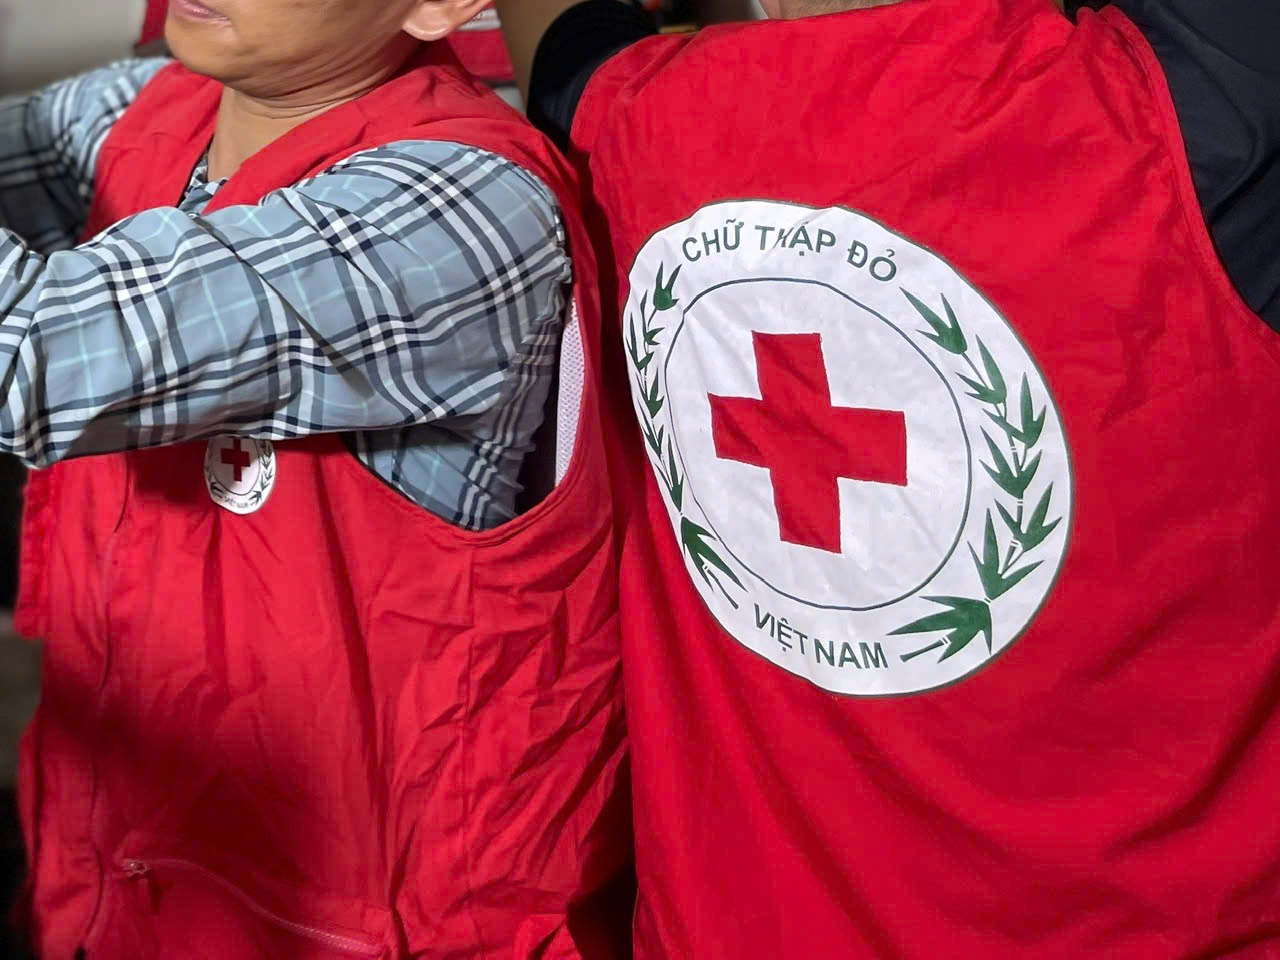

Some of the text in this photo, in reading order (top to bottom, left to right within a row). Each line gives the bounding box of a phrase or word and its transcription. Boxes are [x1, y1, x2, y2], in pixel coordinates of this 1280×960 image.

[682, 218, 744, 262] CHỮ
[847, 239, 898, 282] ĐỎ
[754, 602, 889, 669] VIỆT NAM
